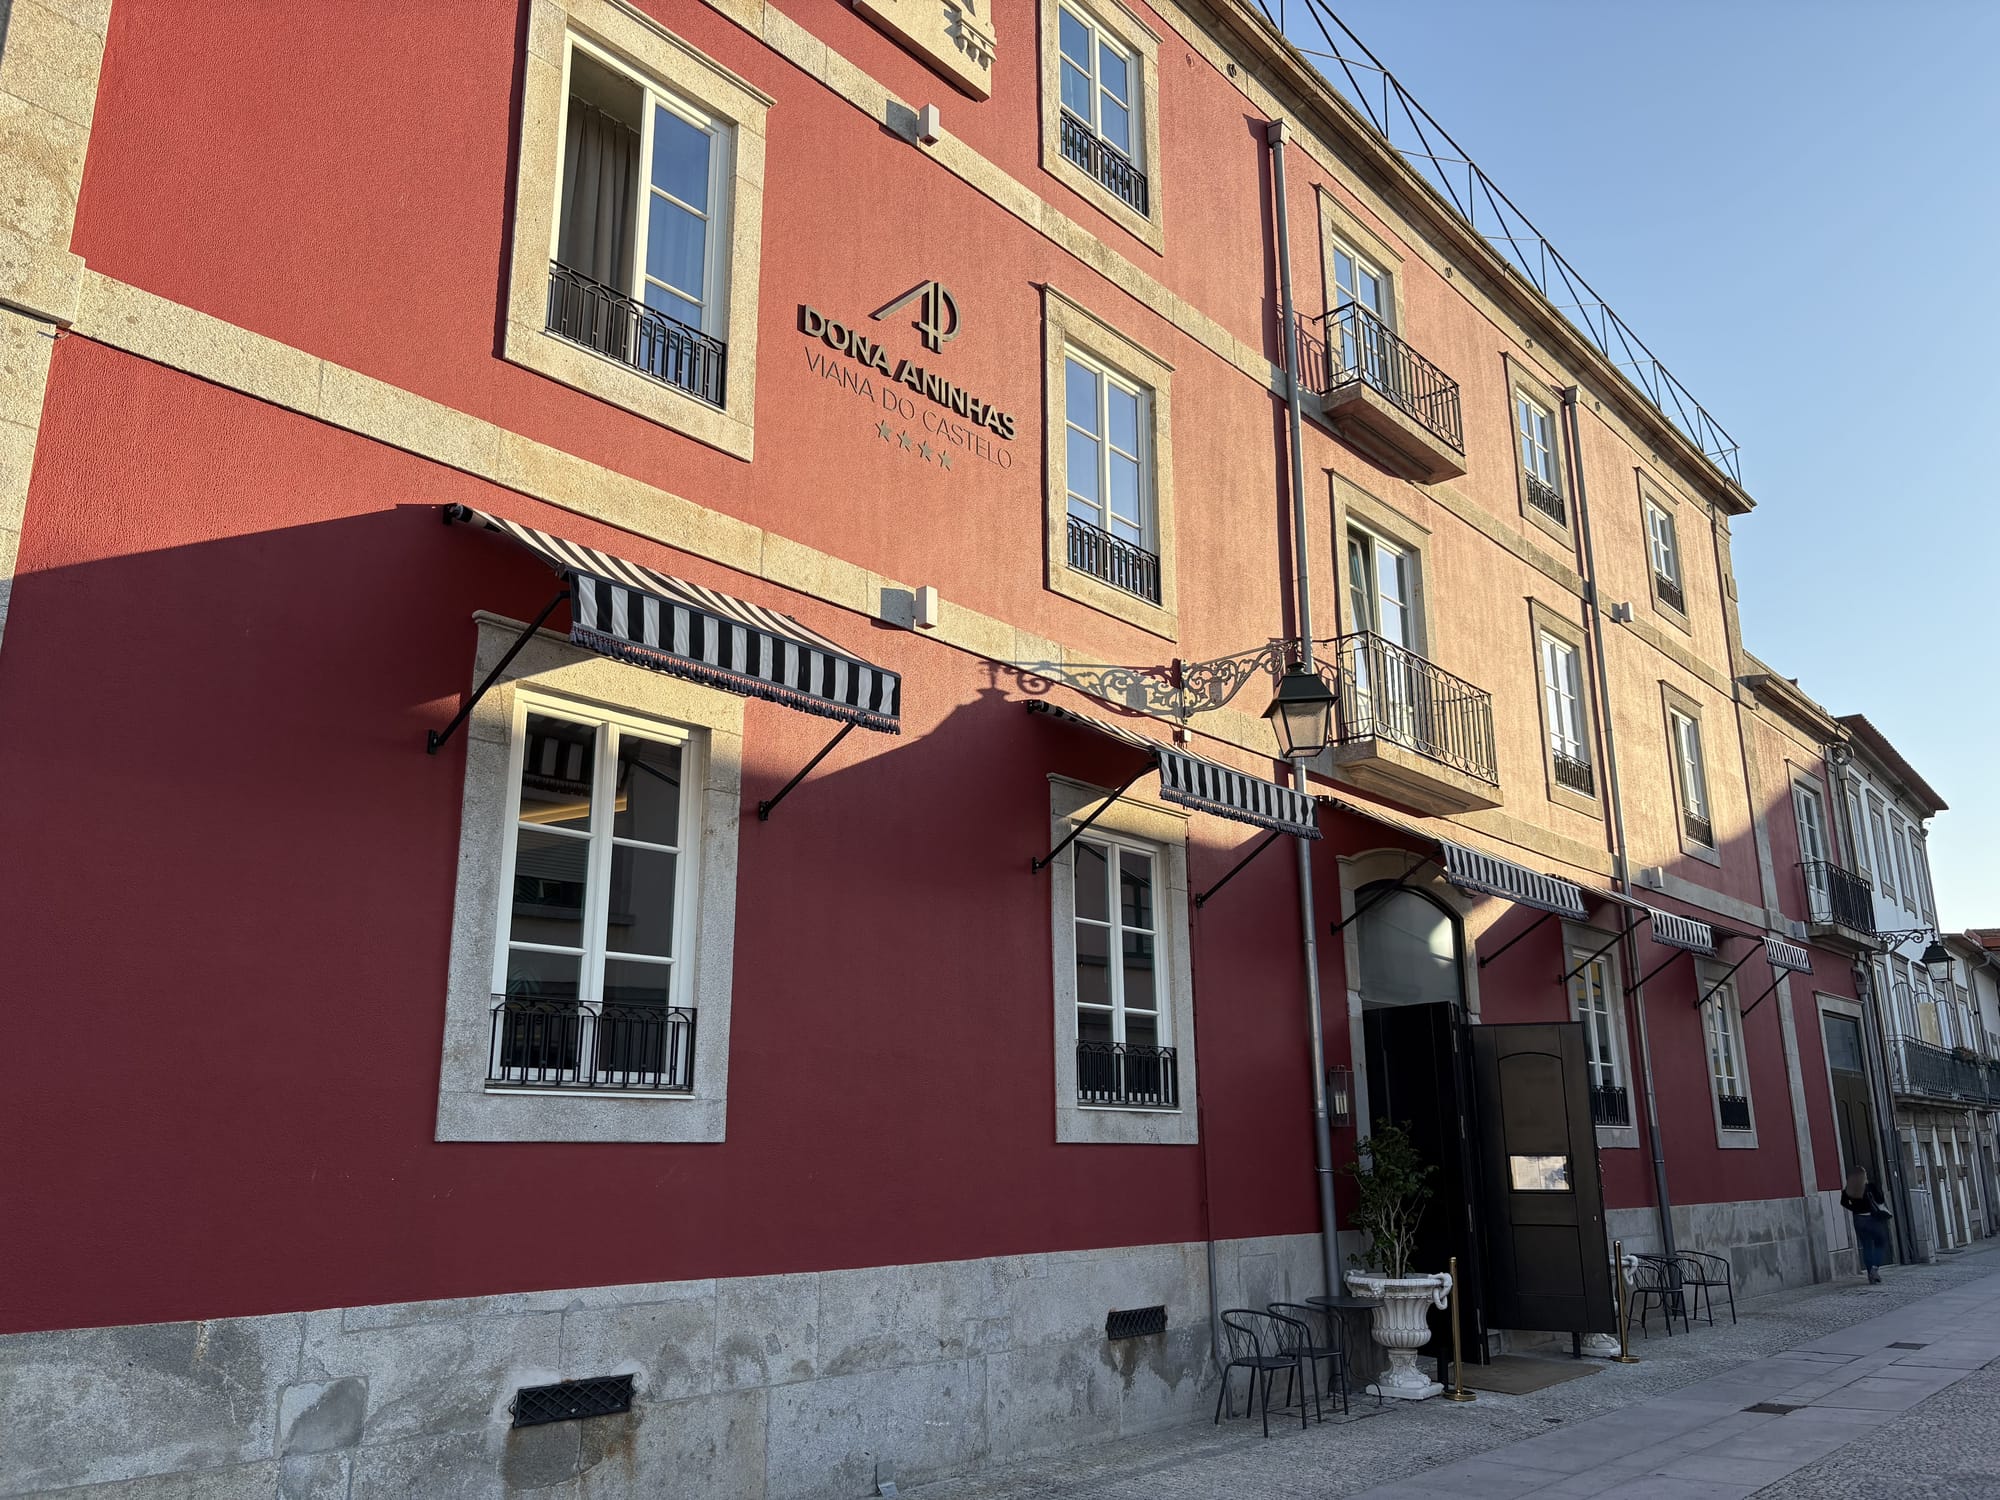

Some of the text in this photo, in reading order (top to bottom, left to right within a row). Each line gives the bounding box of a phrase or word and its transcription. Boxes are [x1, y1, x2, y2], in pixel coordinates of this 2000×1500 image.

[798, 304, 1017, 440] DONA ANINHAS
[804, 346, 1012, 470] VIANA DO CASTELO
